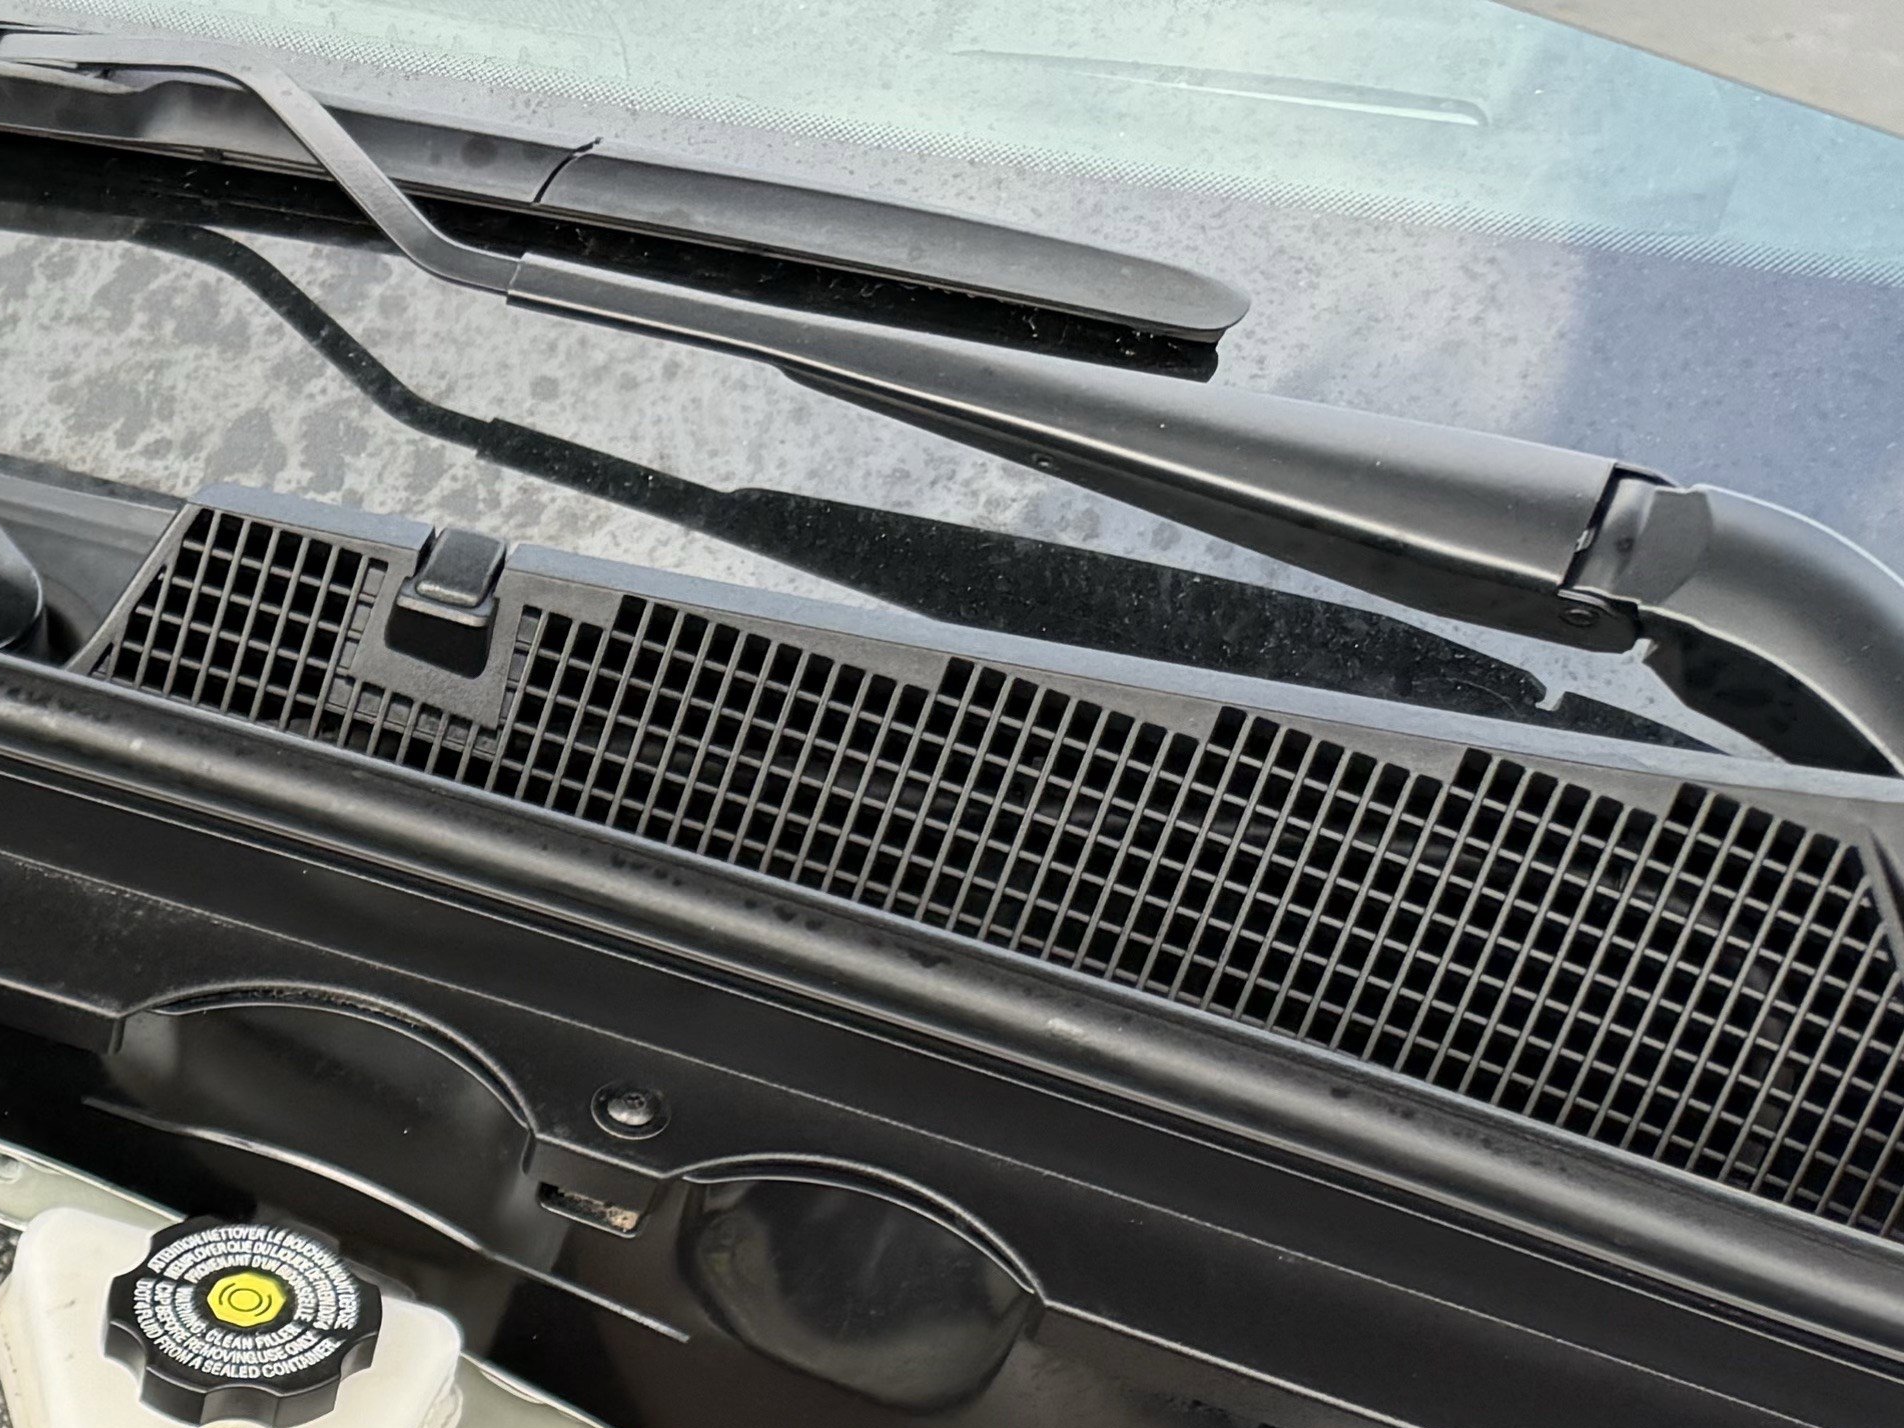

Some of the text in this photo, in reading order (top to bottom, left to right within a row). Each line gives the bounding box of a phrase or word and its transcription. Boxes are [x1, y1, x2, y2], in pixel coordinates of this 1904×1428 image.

[201, 1225, 265, 1245] NETTOYER
[266, 1226, 289, 1243] LE
[227, 1240, 252, 1254] QUE
[253, 1240, 271, 1255] DU
[269, 1245, 314, 1272] LIQUIDE
[305, 1267, 325, 1282] DE
[154, 1305, 191, 1343] BEFORE
[205, 1328, 253, 1350] CLEAN
[255, 1322, 304, 1349] FILLER
[135, 1308, 164, 1339] FLUID
[154, 1335, 193, 1364] FROM
[189, 1356, 204, 1370] A
[201, 1359, 260, 1379] SEALED
